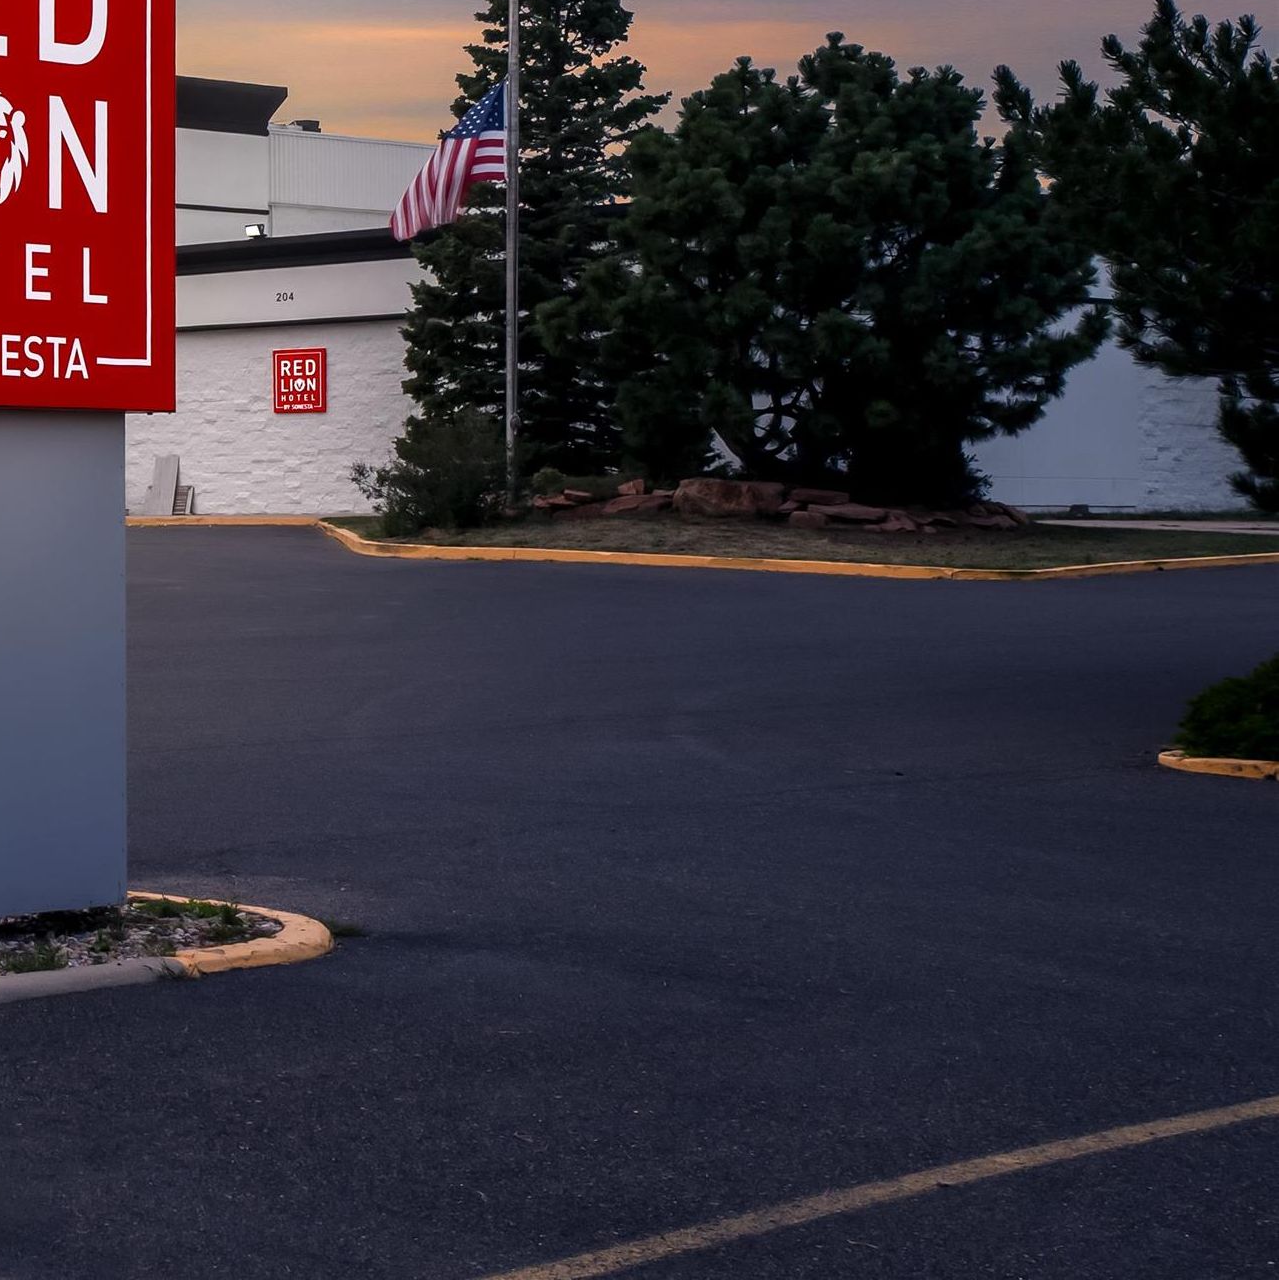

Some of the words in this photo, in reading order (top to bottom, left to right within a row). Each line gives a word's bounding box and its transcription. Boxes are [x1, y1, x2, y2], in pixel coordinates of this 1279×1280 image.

[276, 292, 294, 302] 204
[280, 359, 317, 377] RED
[281, 393, 316, 402] HOTEL
